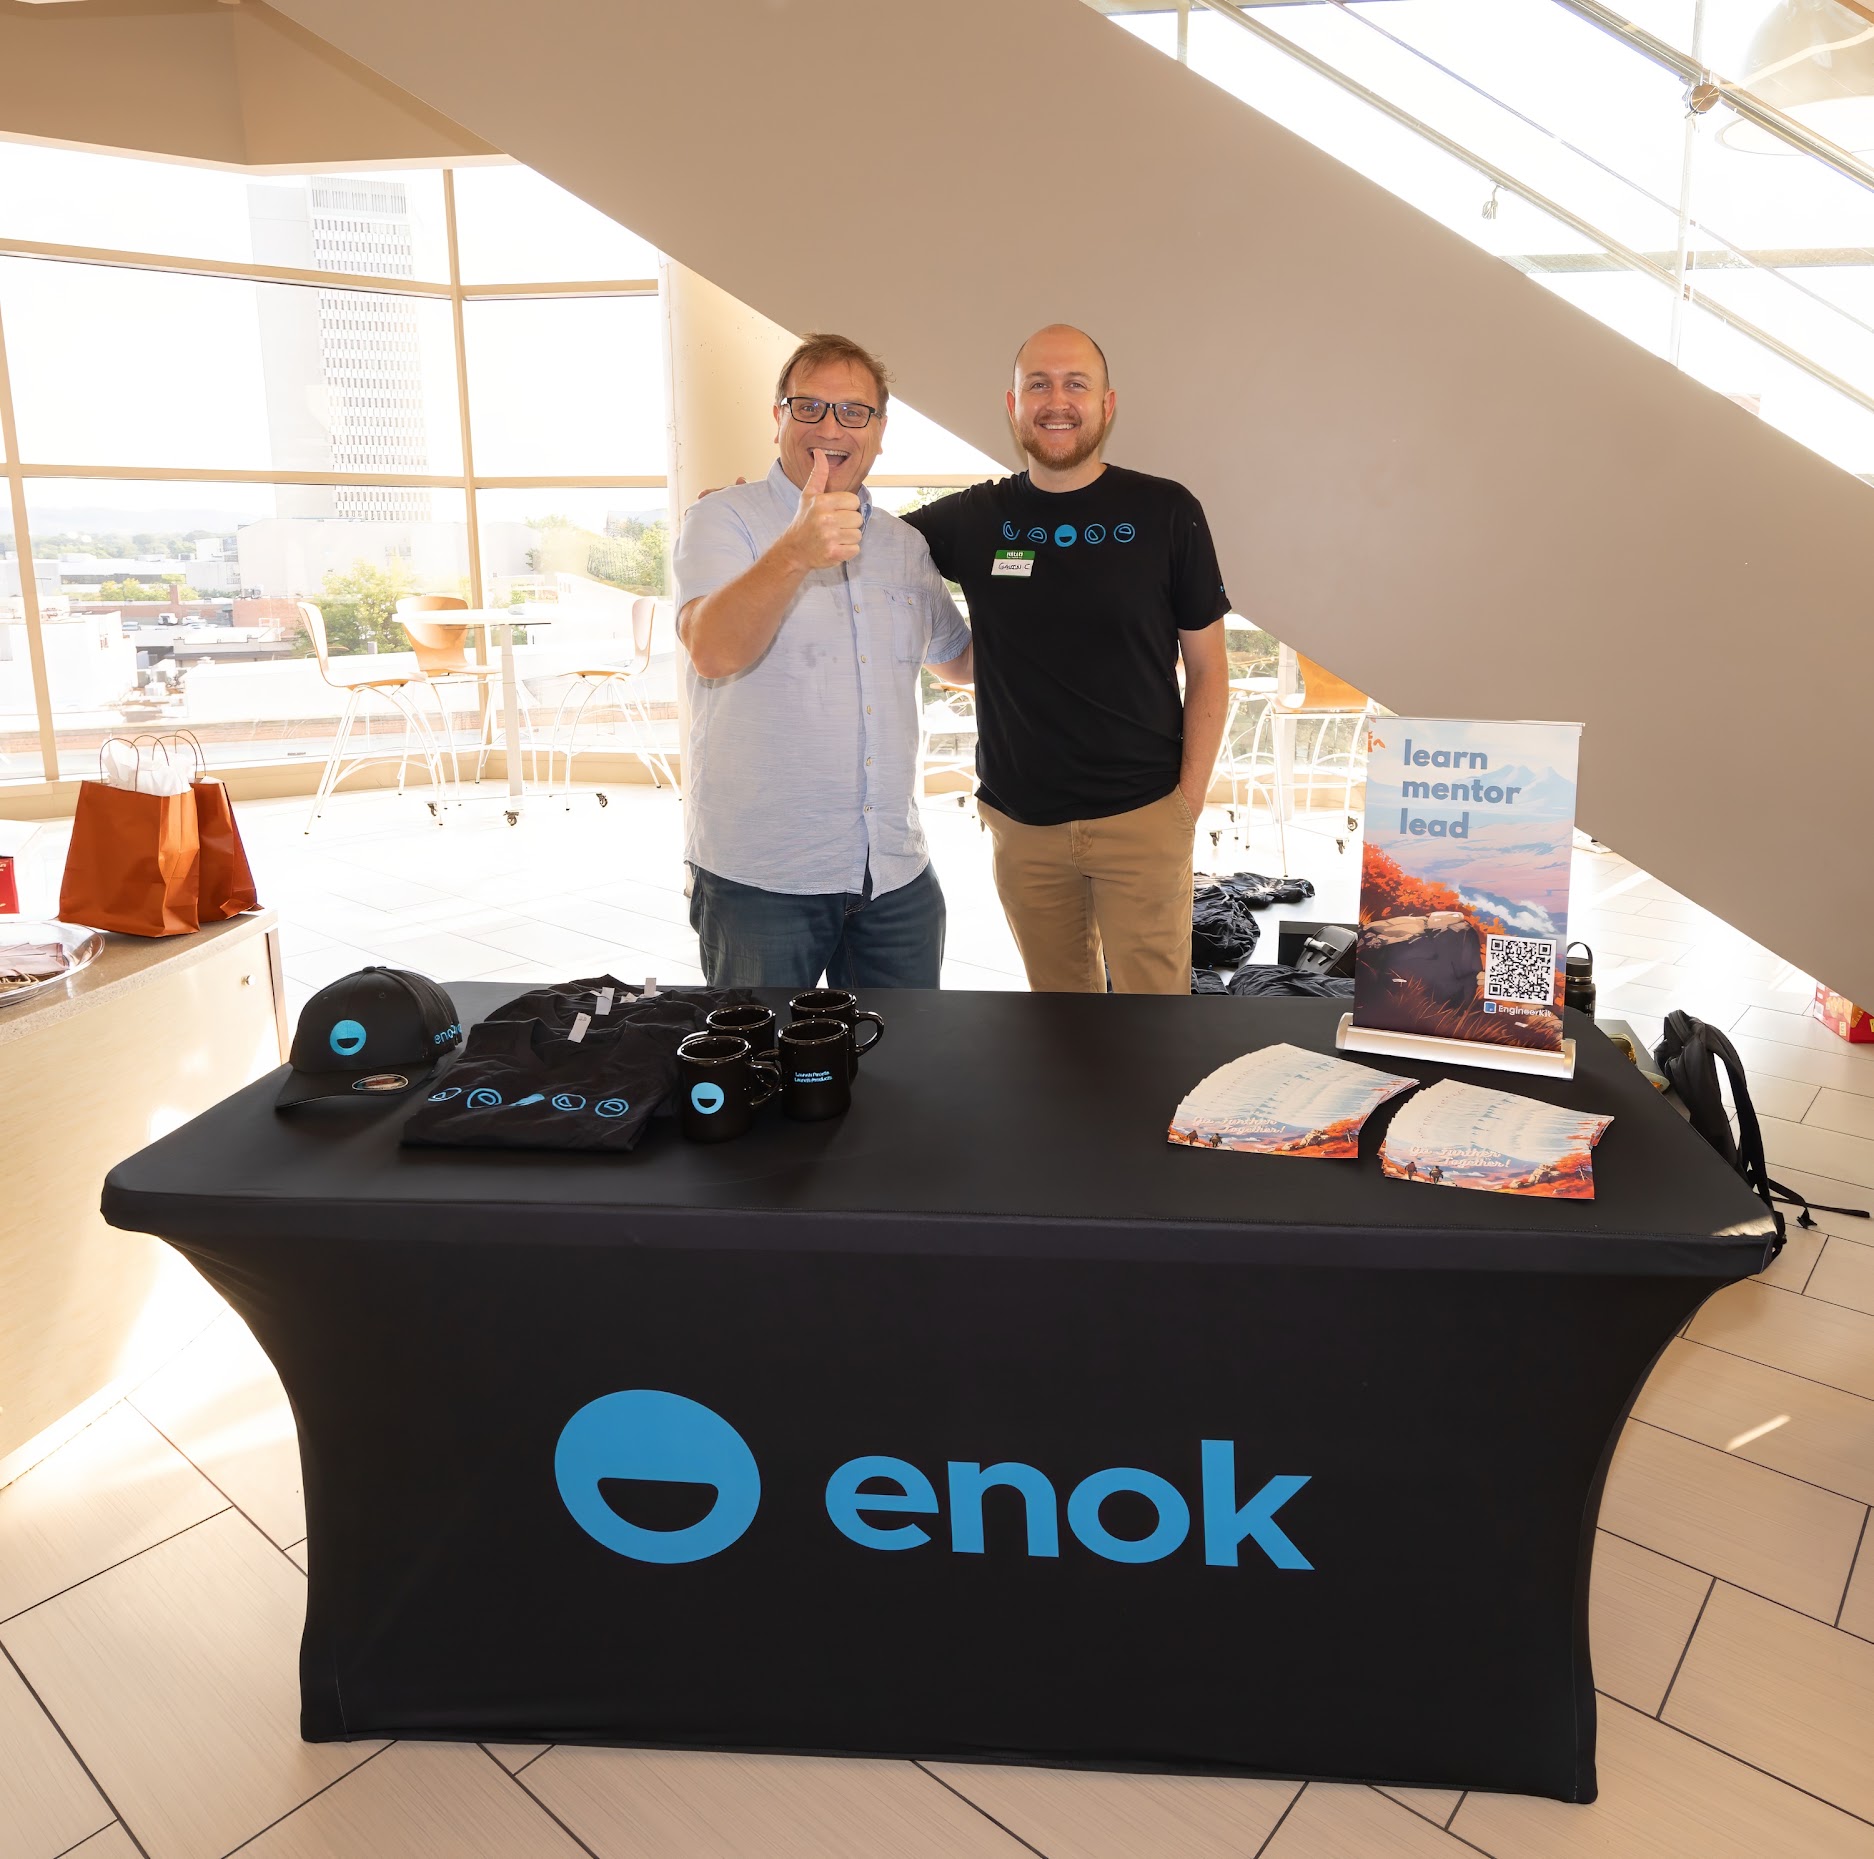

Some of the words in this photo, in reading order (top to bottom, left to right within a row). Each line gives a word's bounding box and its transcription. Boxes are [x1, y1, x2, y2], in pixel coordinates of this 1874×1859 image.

[1403, 738, 1488, 770] learn
[1402, 778, 1522, 804] mentor
[1400, 807, 1470, 839] lead
[825, 1438, 1316, 1571] enok
